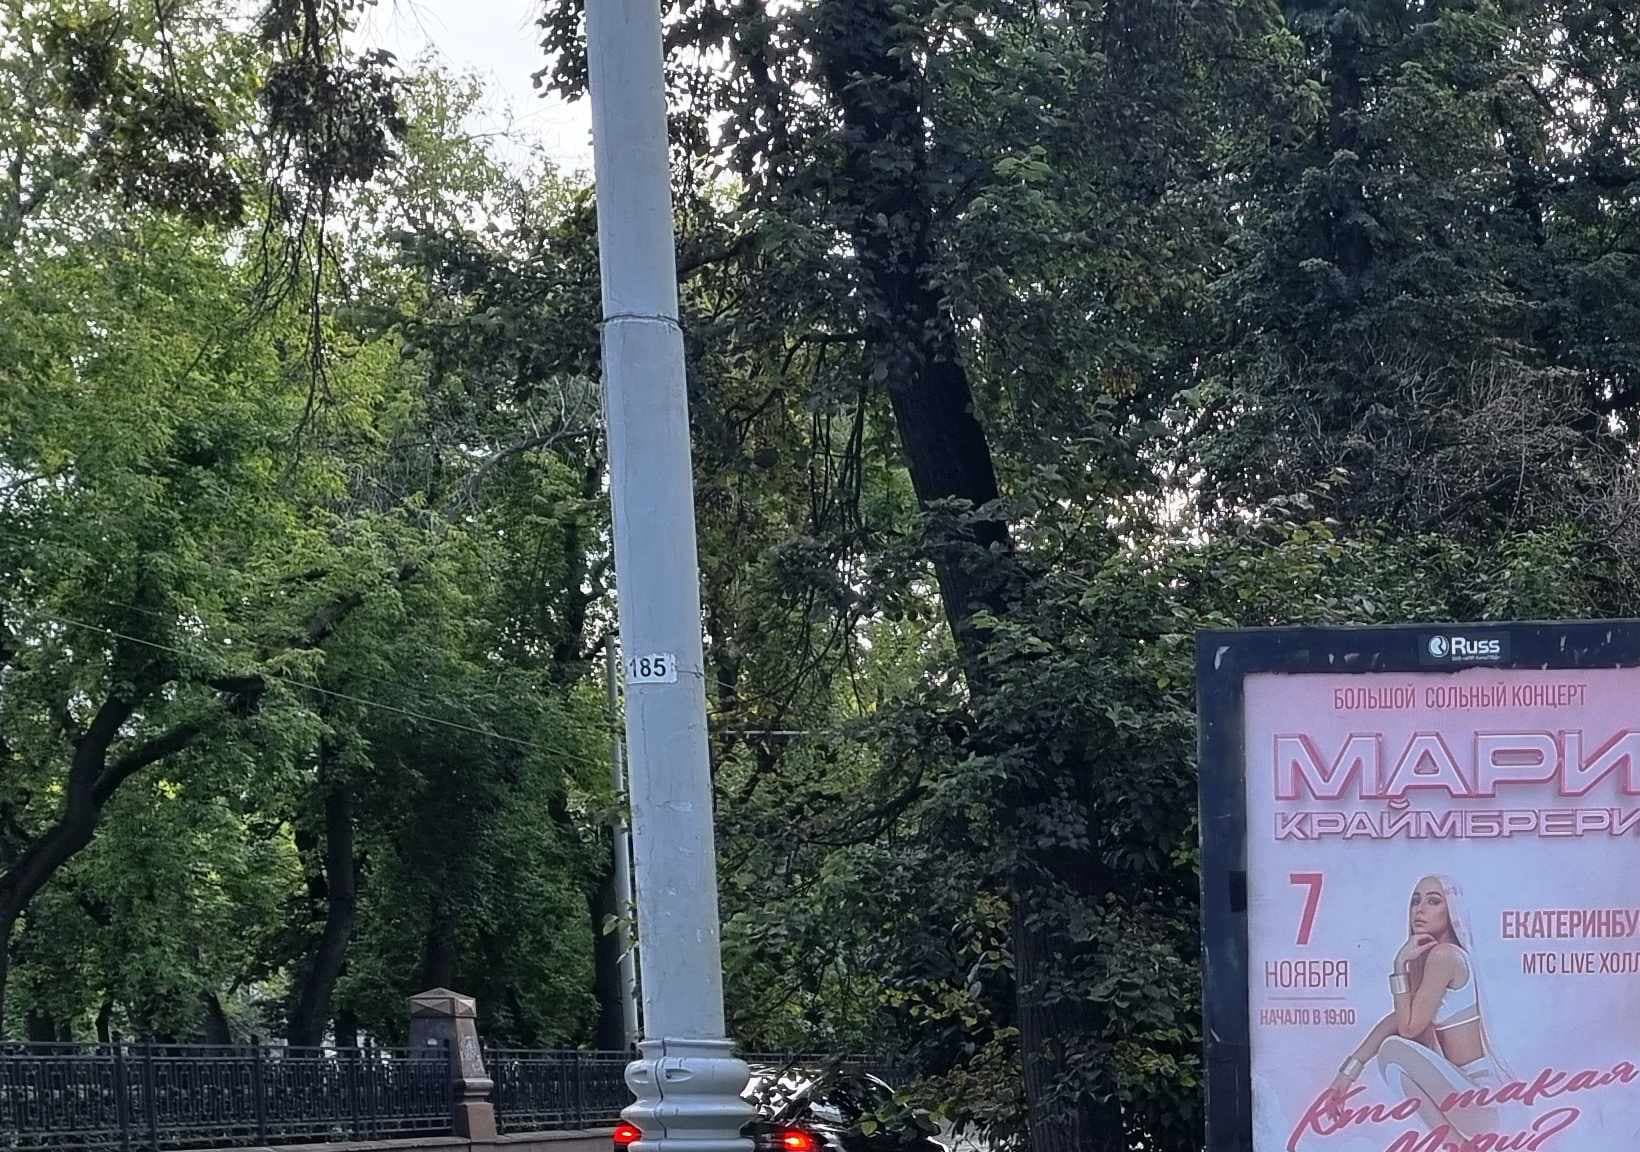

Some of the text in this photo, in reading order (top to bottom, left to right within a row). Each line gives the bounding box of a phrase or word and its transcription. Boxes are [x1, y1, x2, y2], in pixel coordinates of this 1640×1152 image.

[1450, 636, 1501, 656] Russ
[629, 657, 666, 678] 185
[1334, 682, 1588, 711] БОЛЬШОЙ СОЛЬНЫЙ КОНЦЕРТ
[1289, 872, 1325, 946] 7
[1264, 960, 1350, 989] НОЯБРЯ
[1522, 952, 1556, 975] МТС
[1560, 952, 1597, 975] LIVE
[1259, 1008, 1356, 1026] НАЧАЛО В 19:00
[1443, 1059, 1640, 1108] такая
